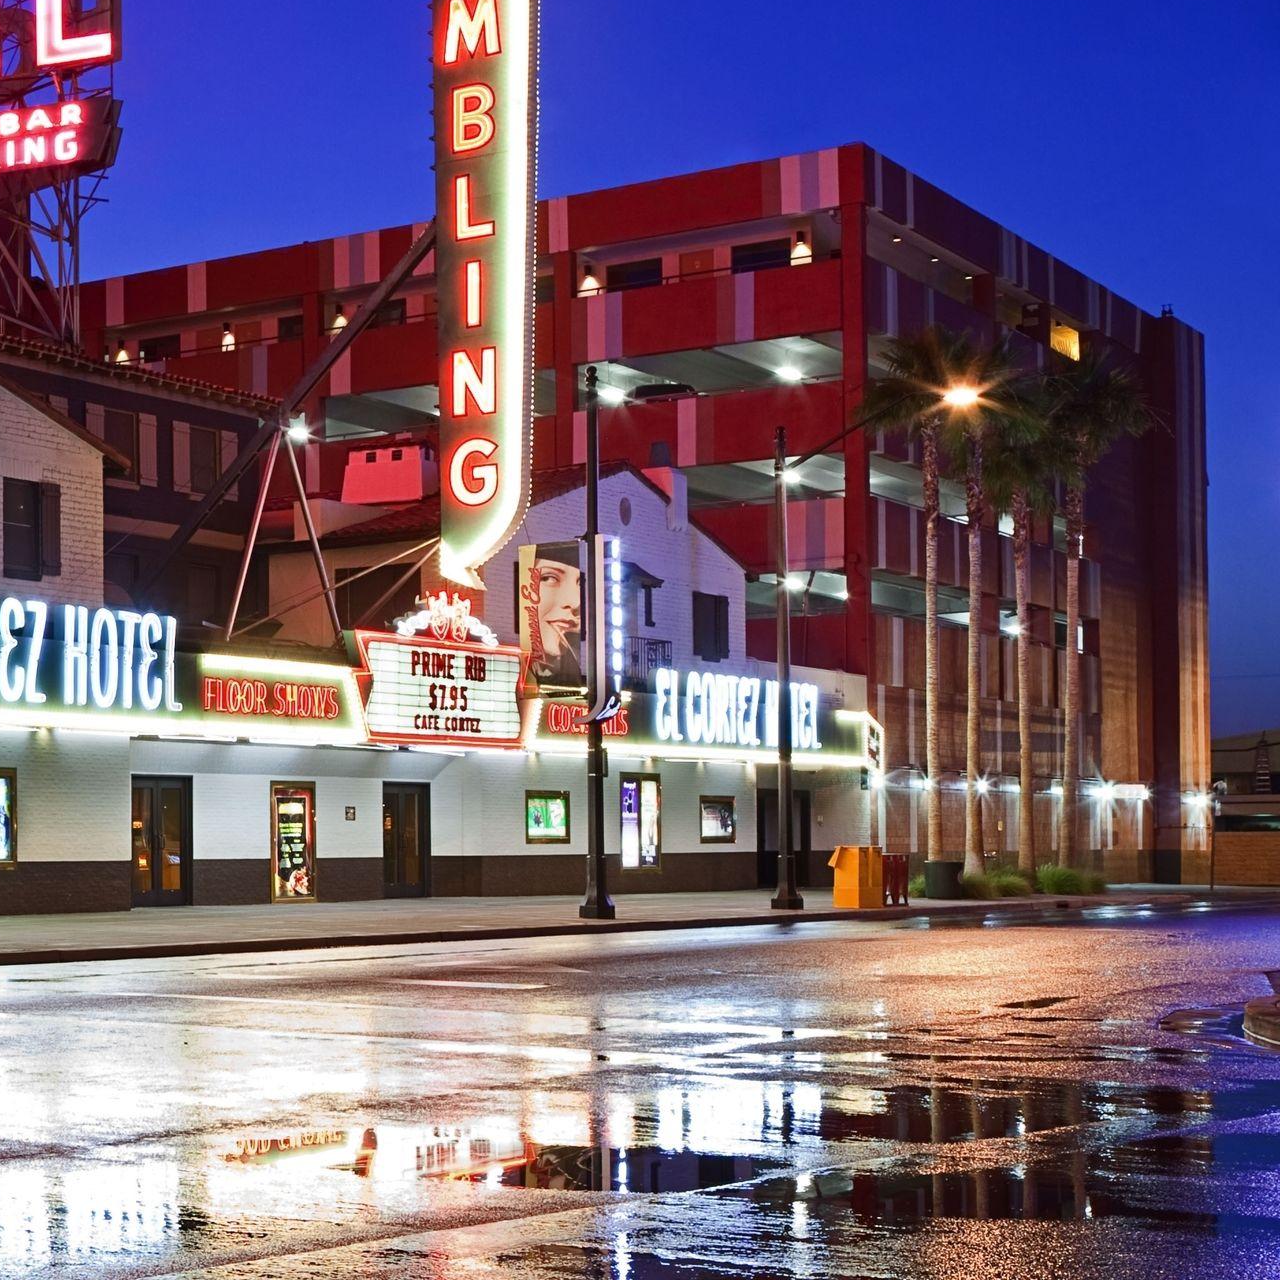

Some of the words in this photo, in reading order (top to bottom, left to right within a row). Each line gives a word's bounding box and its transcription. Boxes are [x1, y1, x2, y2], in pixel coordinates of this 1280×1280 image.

[63, 603, 183, 713] HOTEL
[411, 650, 456, 681] PRIME
[464, 655, 487, 682] RIB
[203, 676, 269, 715] FLOOR
[272, 681, 340, 720] SHOWS
[428, 683, 468, 712] $7.95
[655, 667, 684, 741] EL
[686, 671, 761, 746] CORTEZ
[765, 679, 823, 749] HTEL
[414, 714, 440, 731] CAFE
[444, 716, 482, 733] CORTEZ
